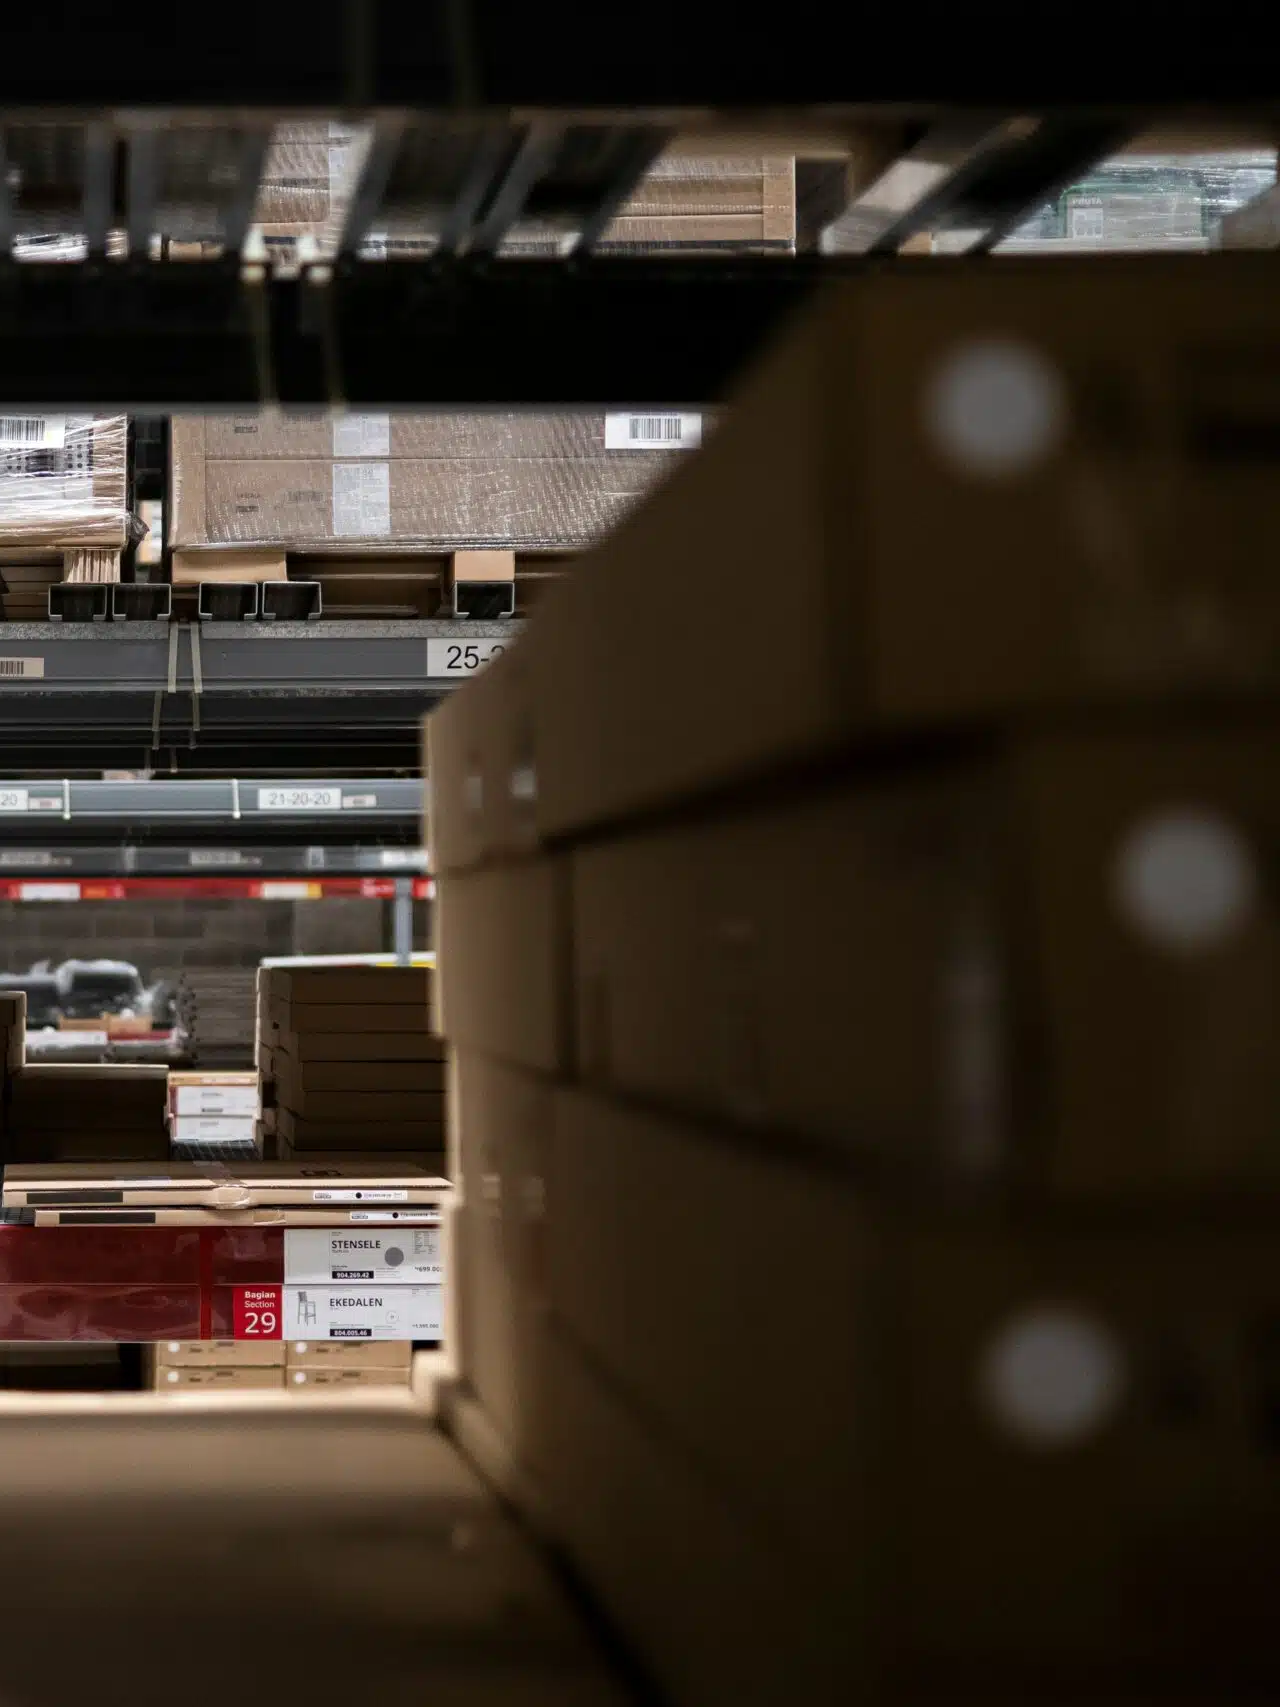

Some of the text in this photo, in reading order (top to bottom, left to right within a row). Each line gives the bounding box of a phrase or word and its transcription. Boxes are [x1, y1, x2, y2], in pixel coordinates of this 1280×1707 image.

[269, 791, 331, 806] 21-20-20
[331, 1240, 381, 1249] STENSELE
[244, 1290, 276, 1300] Bagian
[244, 1300, 275, 1308] Section
[329, 1298, 383, 1307] EKEDALEN
[244, 1312, 276, 1334] 29
